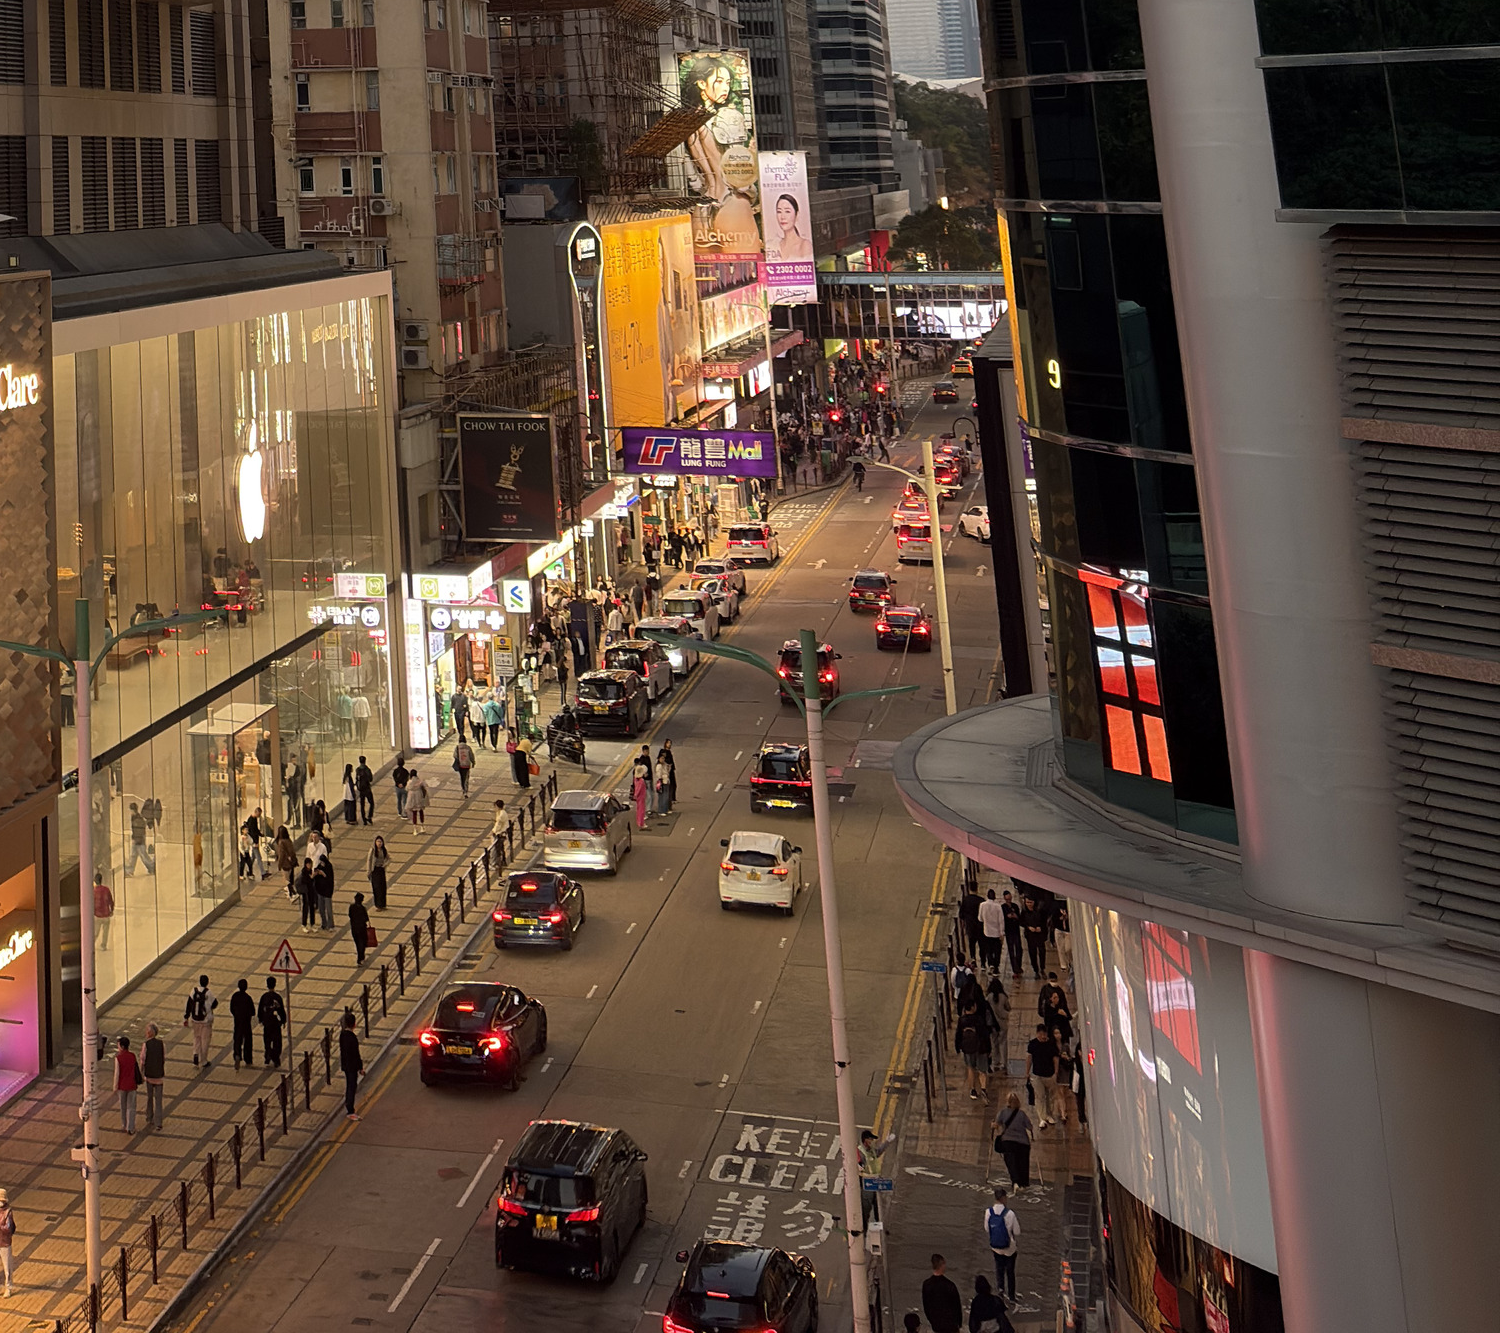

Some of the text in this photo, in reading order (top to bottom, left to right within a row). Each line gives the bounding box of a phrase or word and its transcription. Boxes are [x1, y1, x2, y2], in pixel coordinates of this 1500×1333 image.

[694, 229, 756, 247] Alchemy
[766, 249, 782, 258] FDA
[775, 264, 813, 274] 2302 0002
[1047, 359, 1061, 389] 9
[463, 421, 546, 432] CHOW TAI FOOK
[679, 437, 763, 461] 龍豐 Mall
[681, 459, 727, 469] LUNG FUNG
